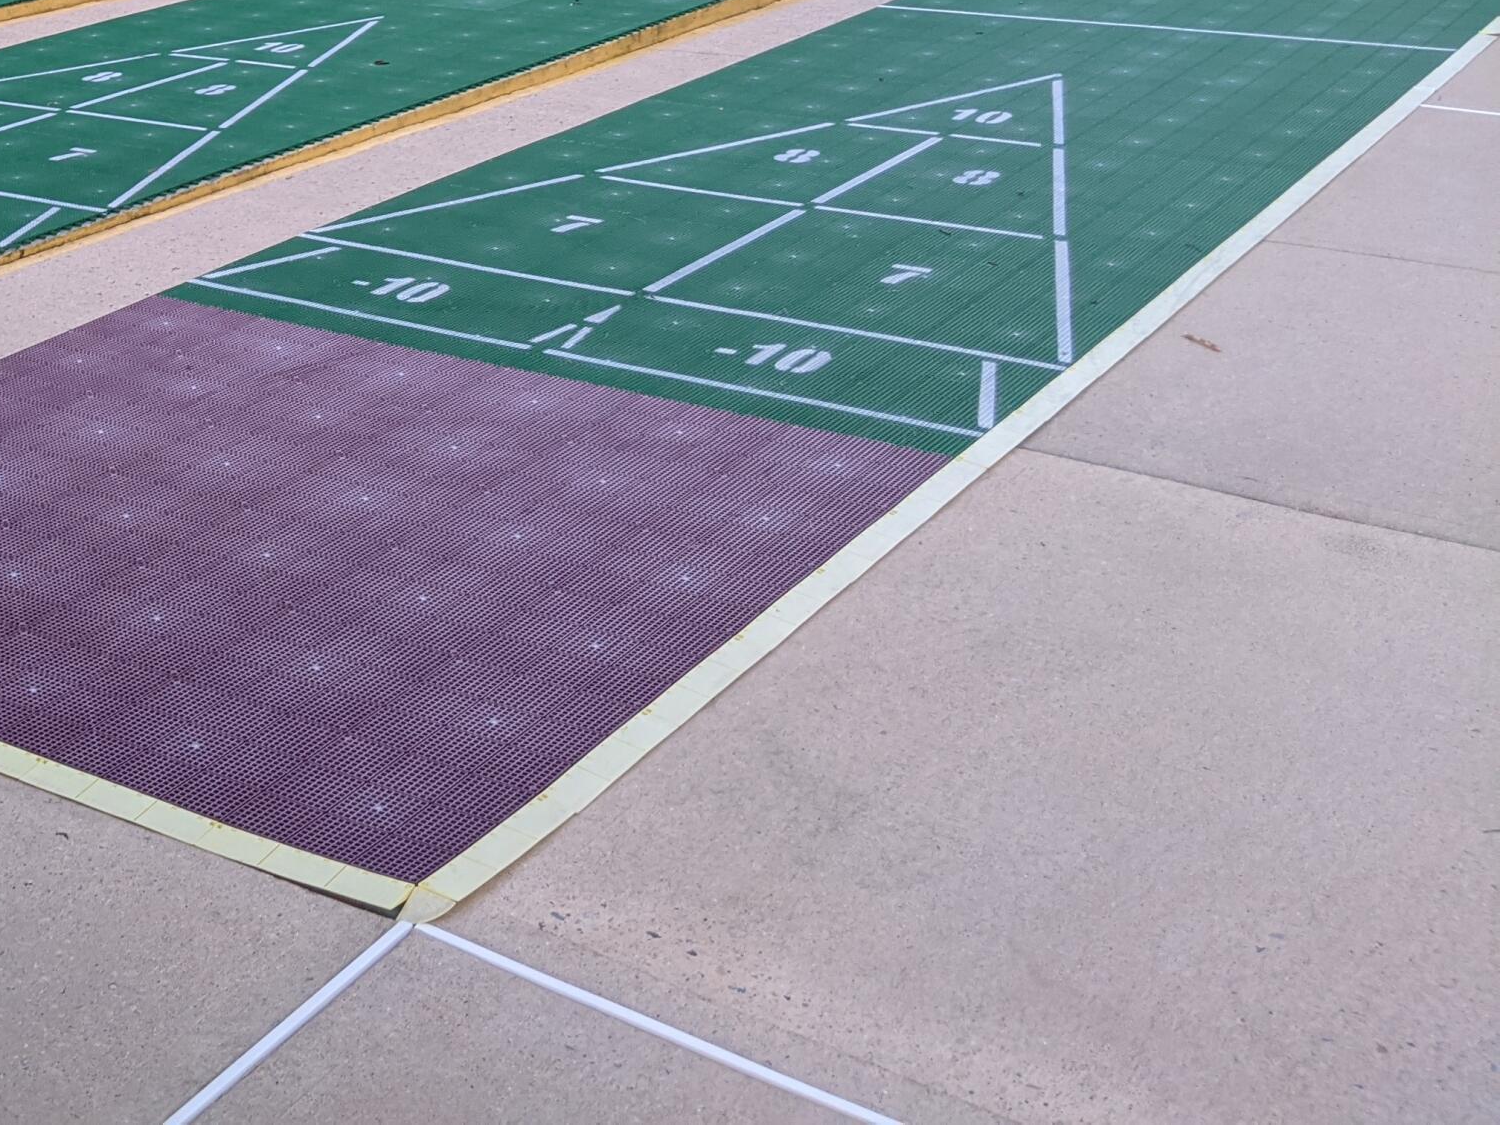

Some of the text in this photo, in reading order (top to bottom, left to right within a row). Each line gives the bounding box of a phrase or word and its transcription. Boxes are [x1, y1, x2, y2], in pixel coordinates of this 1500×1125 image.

[254, 41, 305, 54] 10
[81, 71, 122, 83] 8
[194, 83, 236, 96] 8
[951, 108, 1013, 126] 10
[49, 147, 97, 162] 7
[773, 148, 821, 164] 8
[952, 169, 1001, 186] 8
[551, 214, 604, 233] 7
[880, 263, 933, 285] 7
[352, 276, 451, 304] -10
[714, 343, 833, 374] -10
